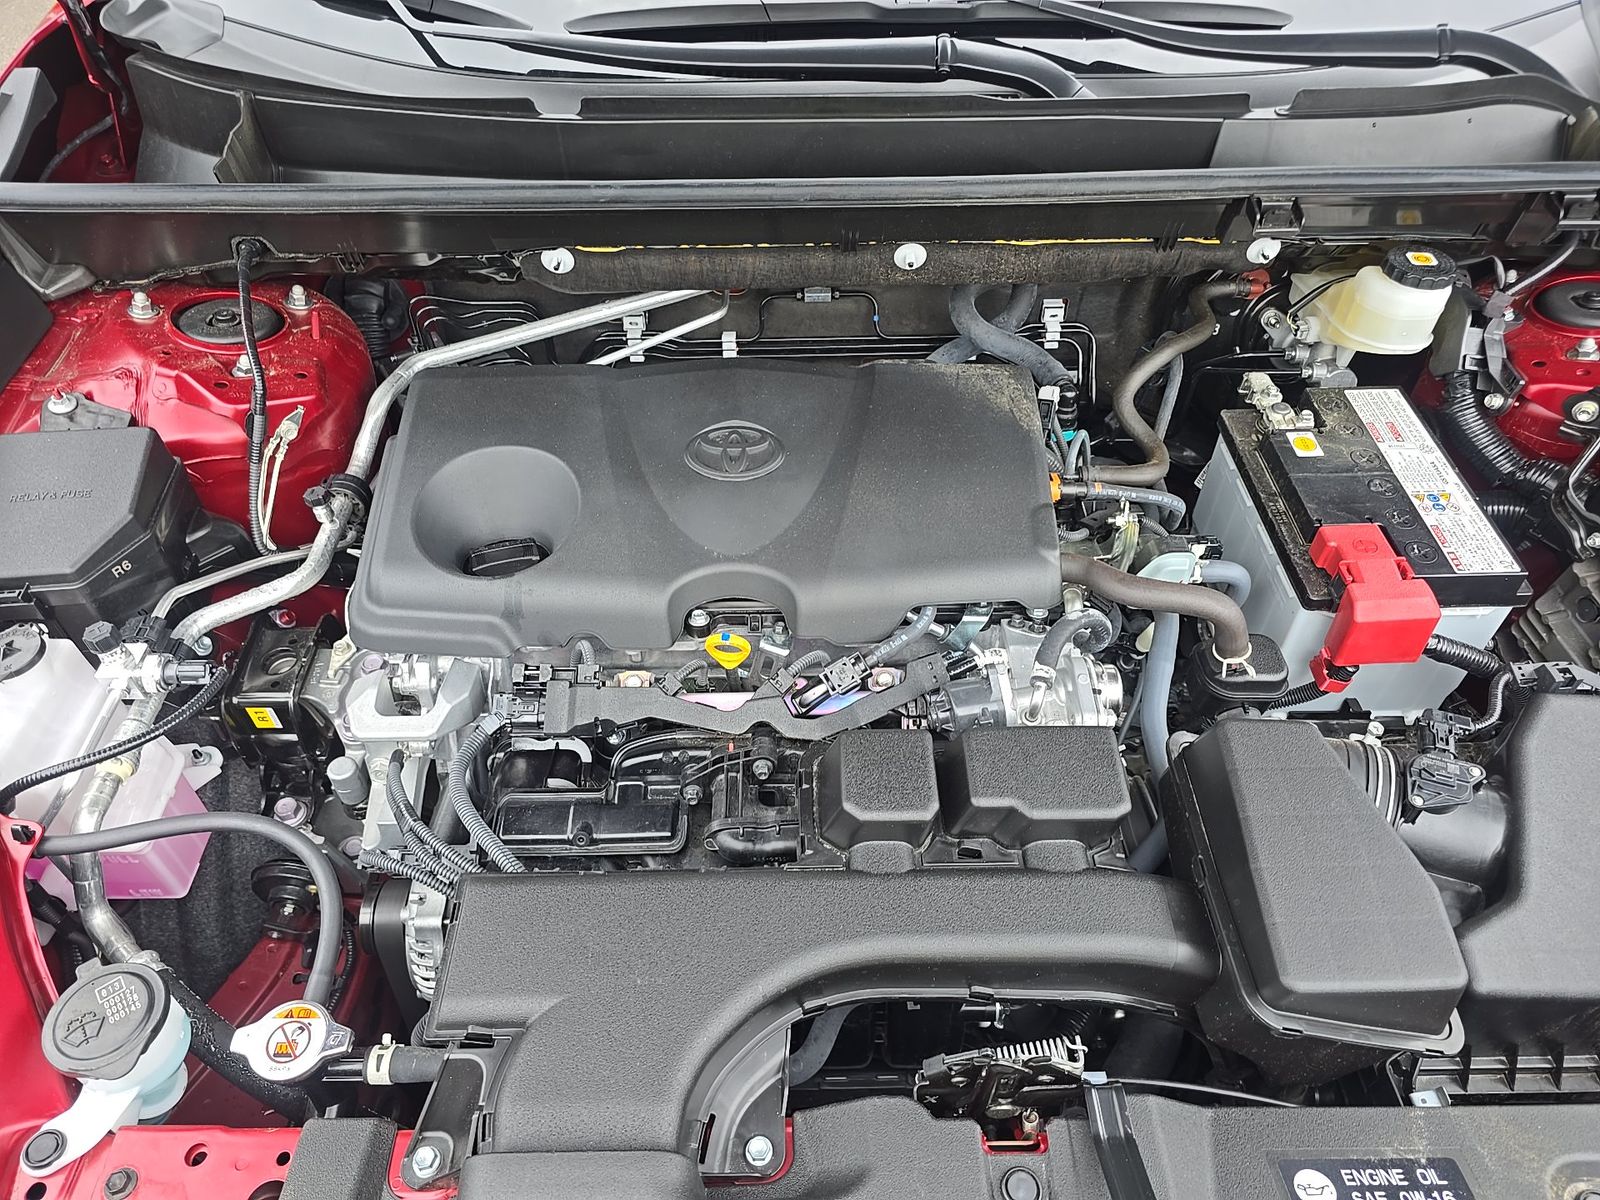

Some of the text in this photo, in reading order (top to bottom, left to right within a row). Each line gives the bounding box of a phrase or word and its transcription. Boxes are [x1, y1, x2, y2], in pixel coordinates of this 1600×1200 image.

[9, 488, 93, 503] RELAY & FUSE
[111, 560, 132, 579] R6
[254, 711, 269, 722] R1
[104, 985, 135, 1009] 000127
[1340, 1169, 1449, 1186] ENGINE OIL
